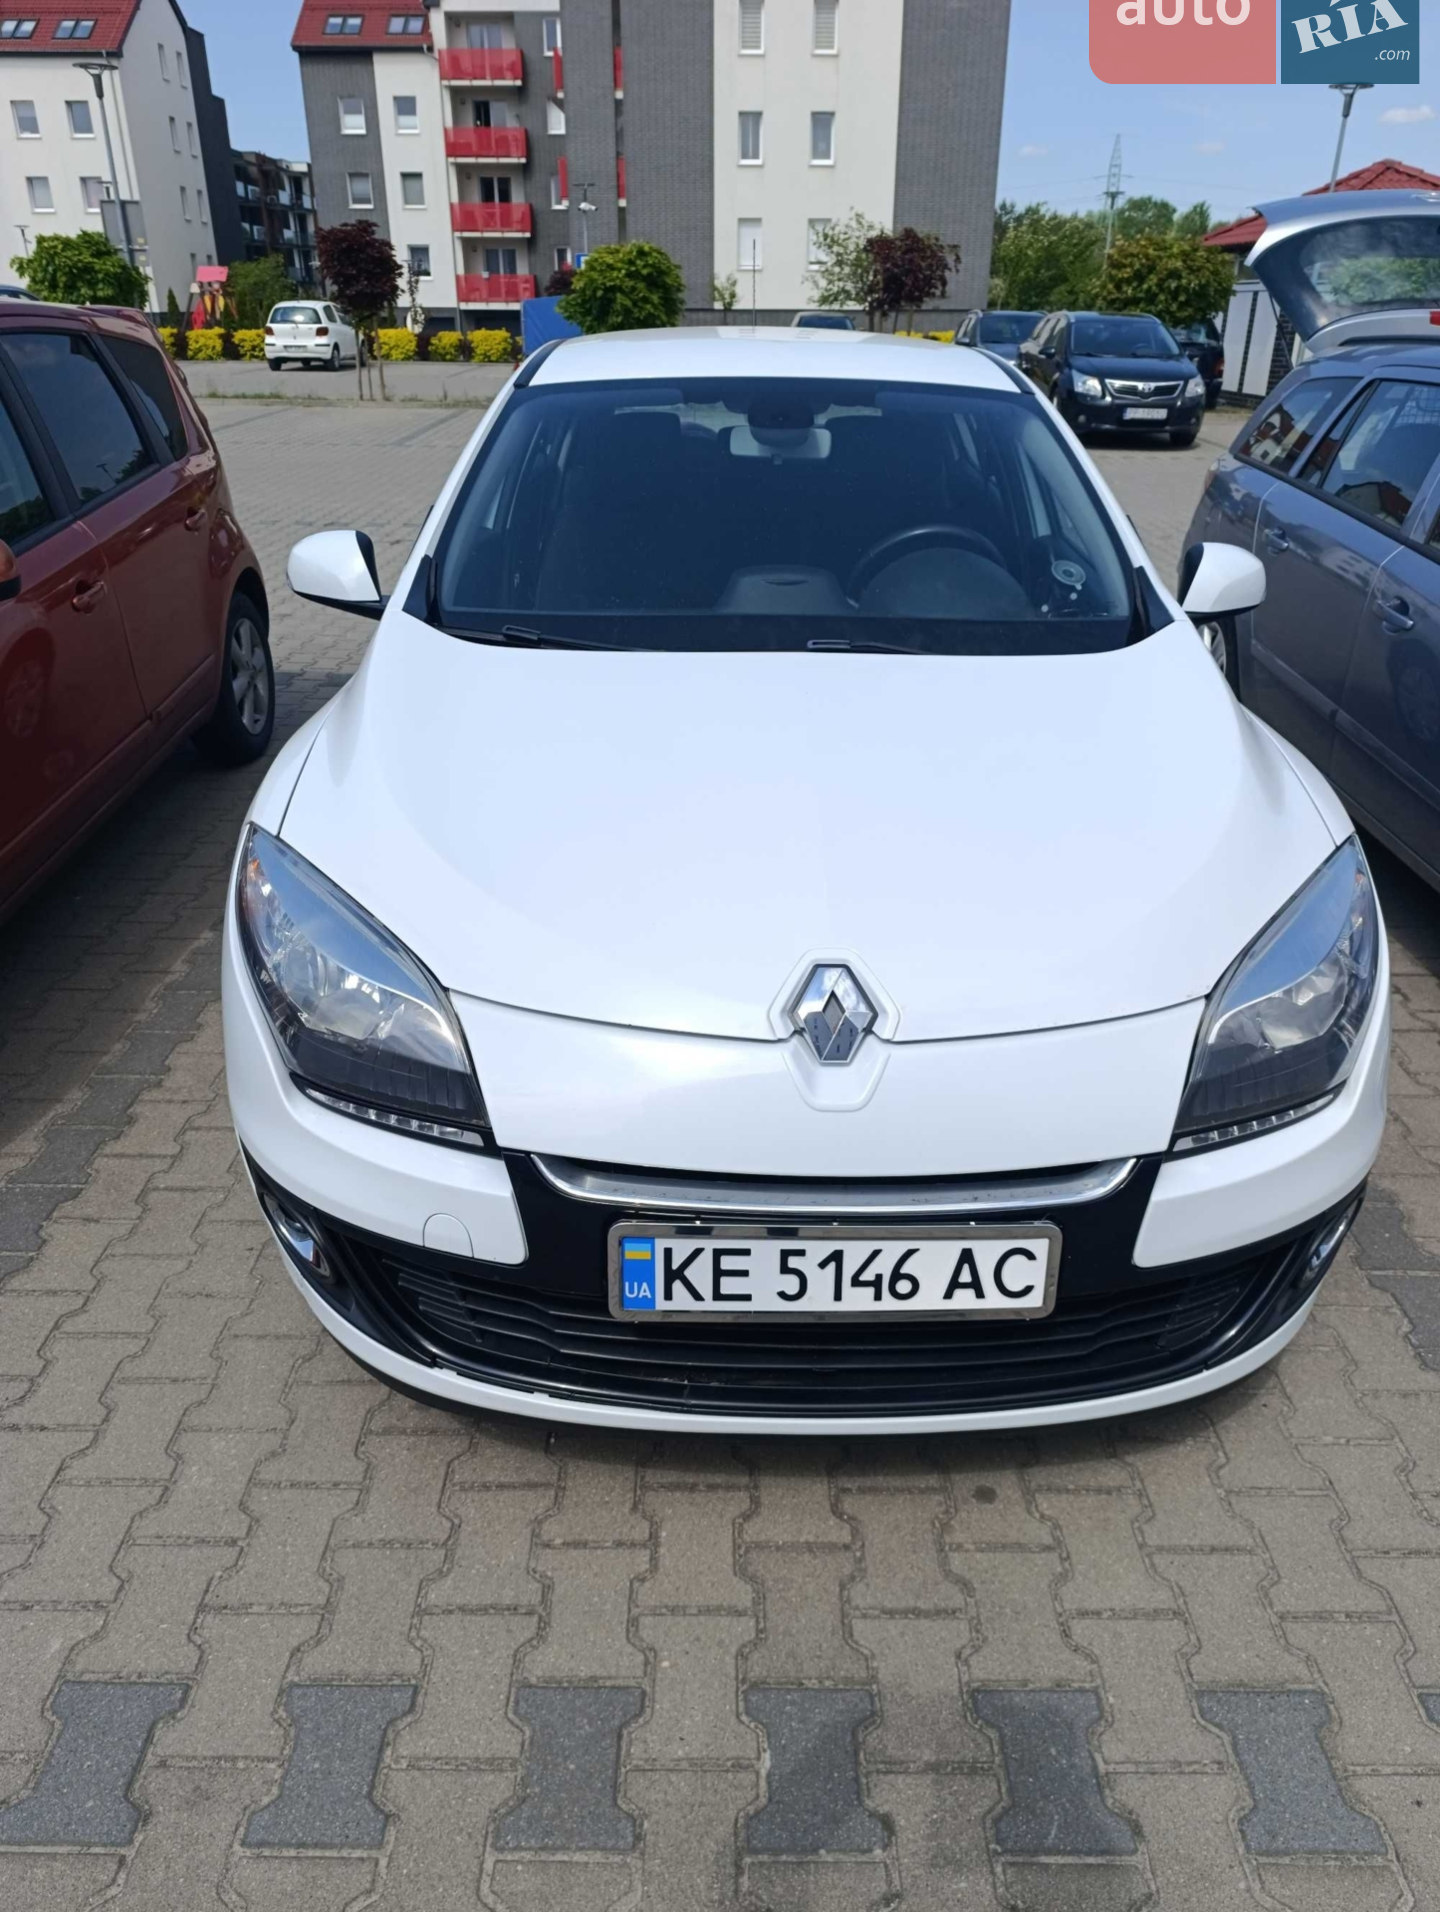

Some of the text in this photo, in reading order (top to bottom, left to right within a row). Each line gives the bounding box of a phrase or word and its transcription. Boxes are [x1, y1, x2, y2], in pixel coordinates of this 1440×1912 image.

[625, 1281, 652, 1299] UA
[663, 1246, 1038, 1302] KE 5146 AC
